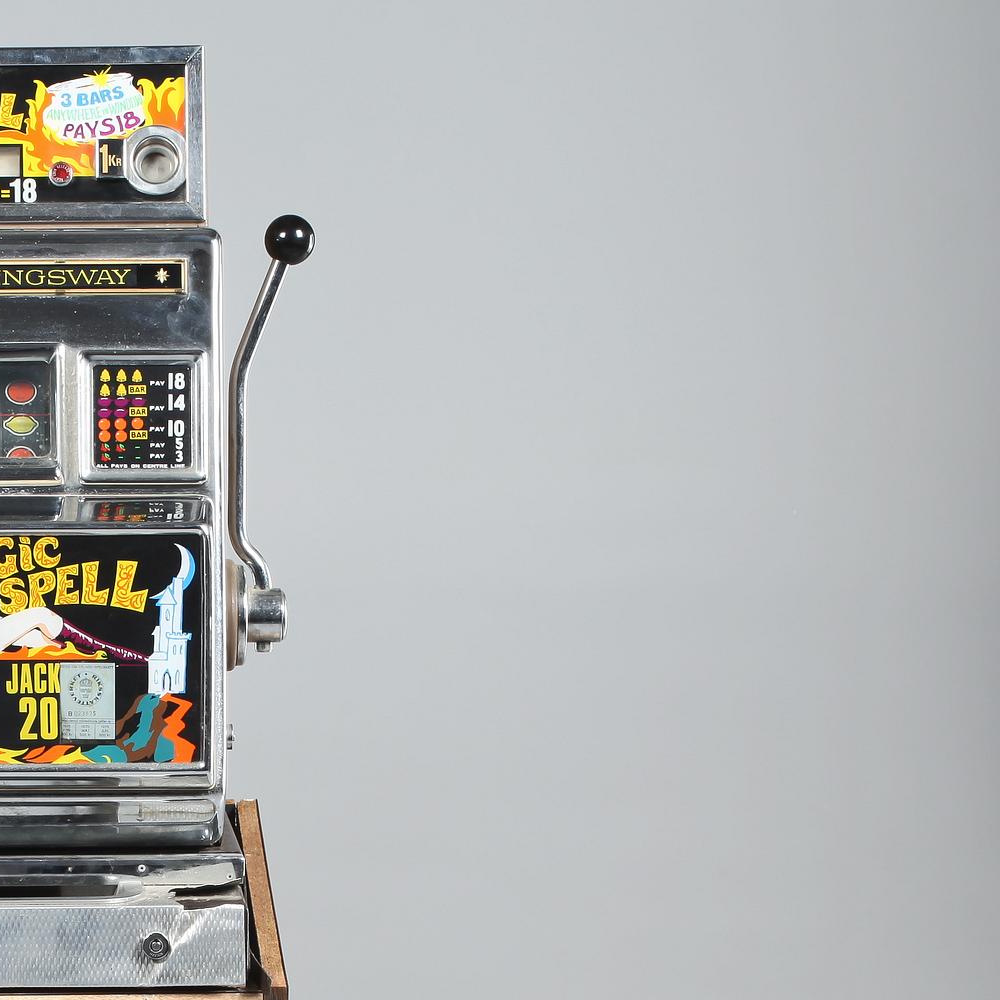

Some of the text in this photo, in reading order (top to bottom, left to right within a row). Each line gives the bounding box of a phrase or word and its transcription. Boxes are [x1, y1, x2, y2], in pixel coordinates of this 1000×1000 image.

[60, 85, 124, 108] 3 BARS
[167, 372, 186, 390] 18
[167, 393, 186, 411] 14
[167, 419, 185, 437] 10
[175, 437, 184, 450] 5
[175, 450, 184, 463] 3
[18, 696, 59, 740] 20
